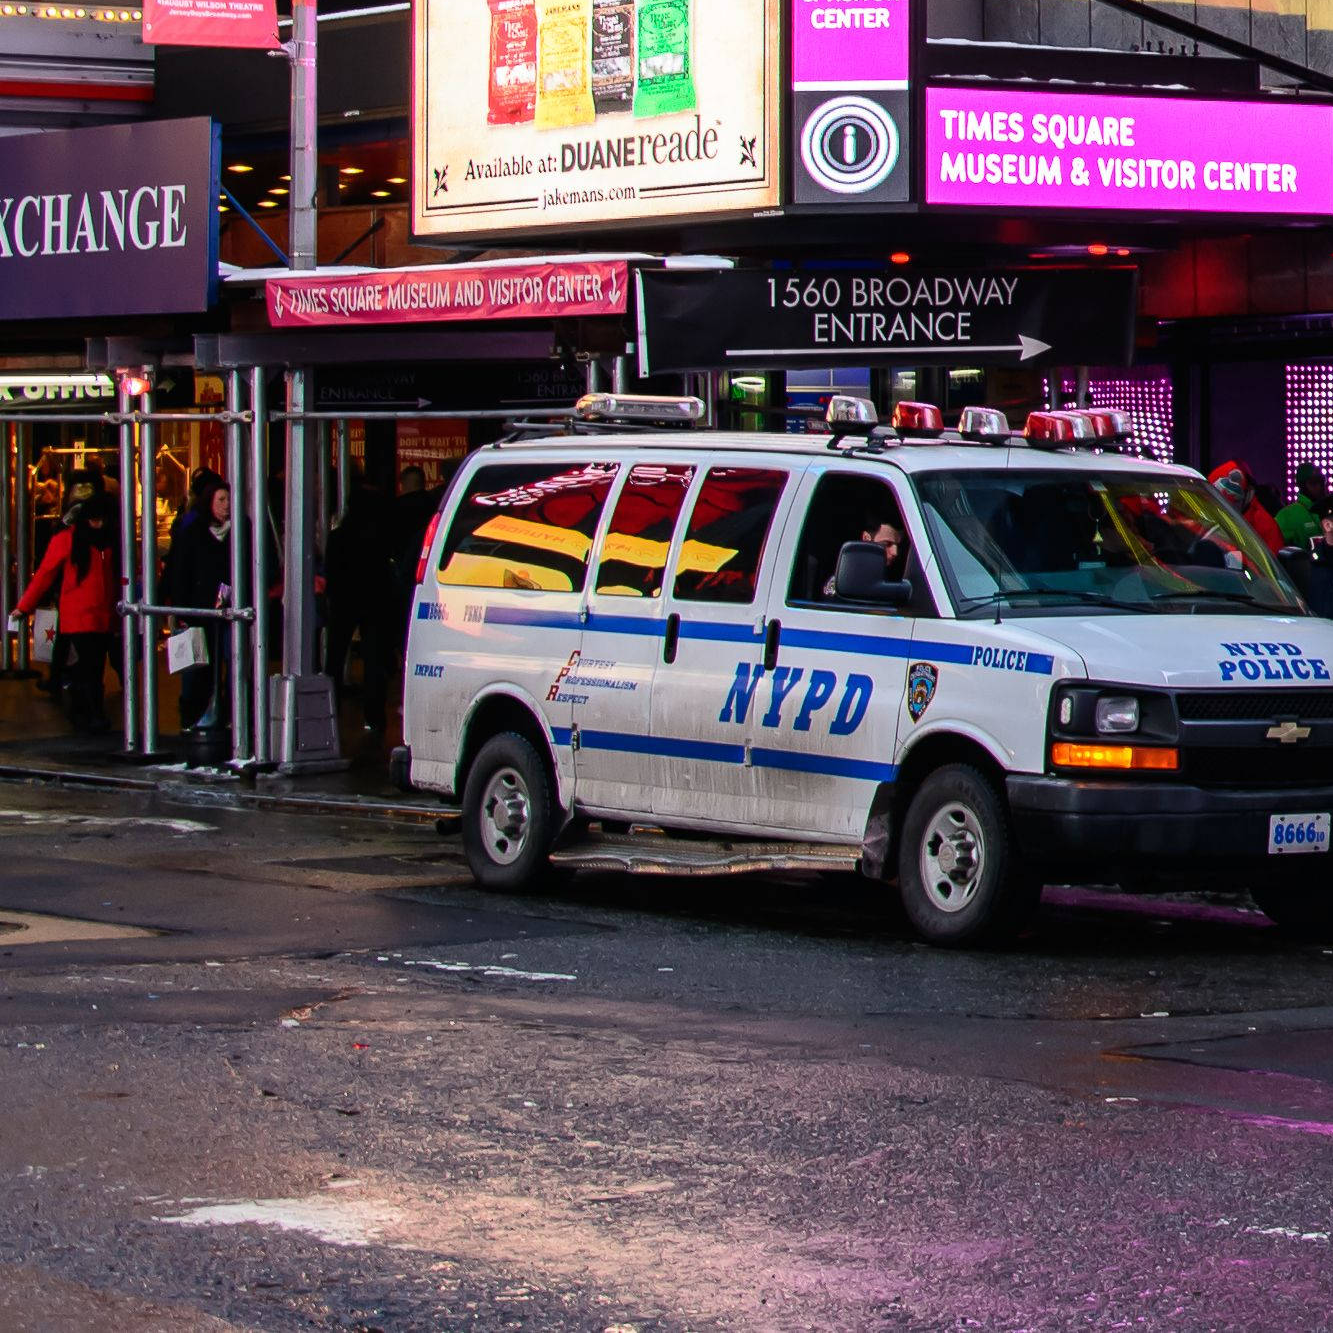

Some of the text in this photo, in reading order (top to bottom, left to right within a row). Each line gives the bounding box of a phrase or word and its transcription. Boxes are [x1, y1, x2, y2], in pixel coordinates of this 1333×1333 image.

[810, 7, 890, 30] CENTER
[940, 109, 1136, 150] TIMES SQUARE
[465, 154, 533, 180] Available
[538, 156, 557, 175] at:
[940, 152, 1298, 193] MUSEUM & VISITOR CENTER
[543, 184, 636, 210] jakemans.com
[289, 273, 604, 317] TIMES SQUARE MUSEUM AND VISITOR CENTER
[767, 277, 1018, 308] 1560 BROADWAY
[814, 312, 971, 342] ENTRANCE
[972, 645, 1027, 672] POLICE
[1219, 642, 1302, 656] NYPD
[415, 663, 444, 678] IMPACT
[555, 667, 638, 691] PROFESSIONALISM
[1217, 659, 1331, 682] POLICE
[719, 662, 874, 736] NYPD
